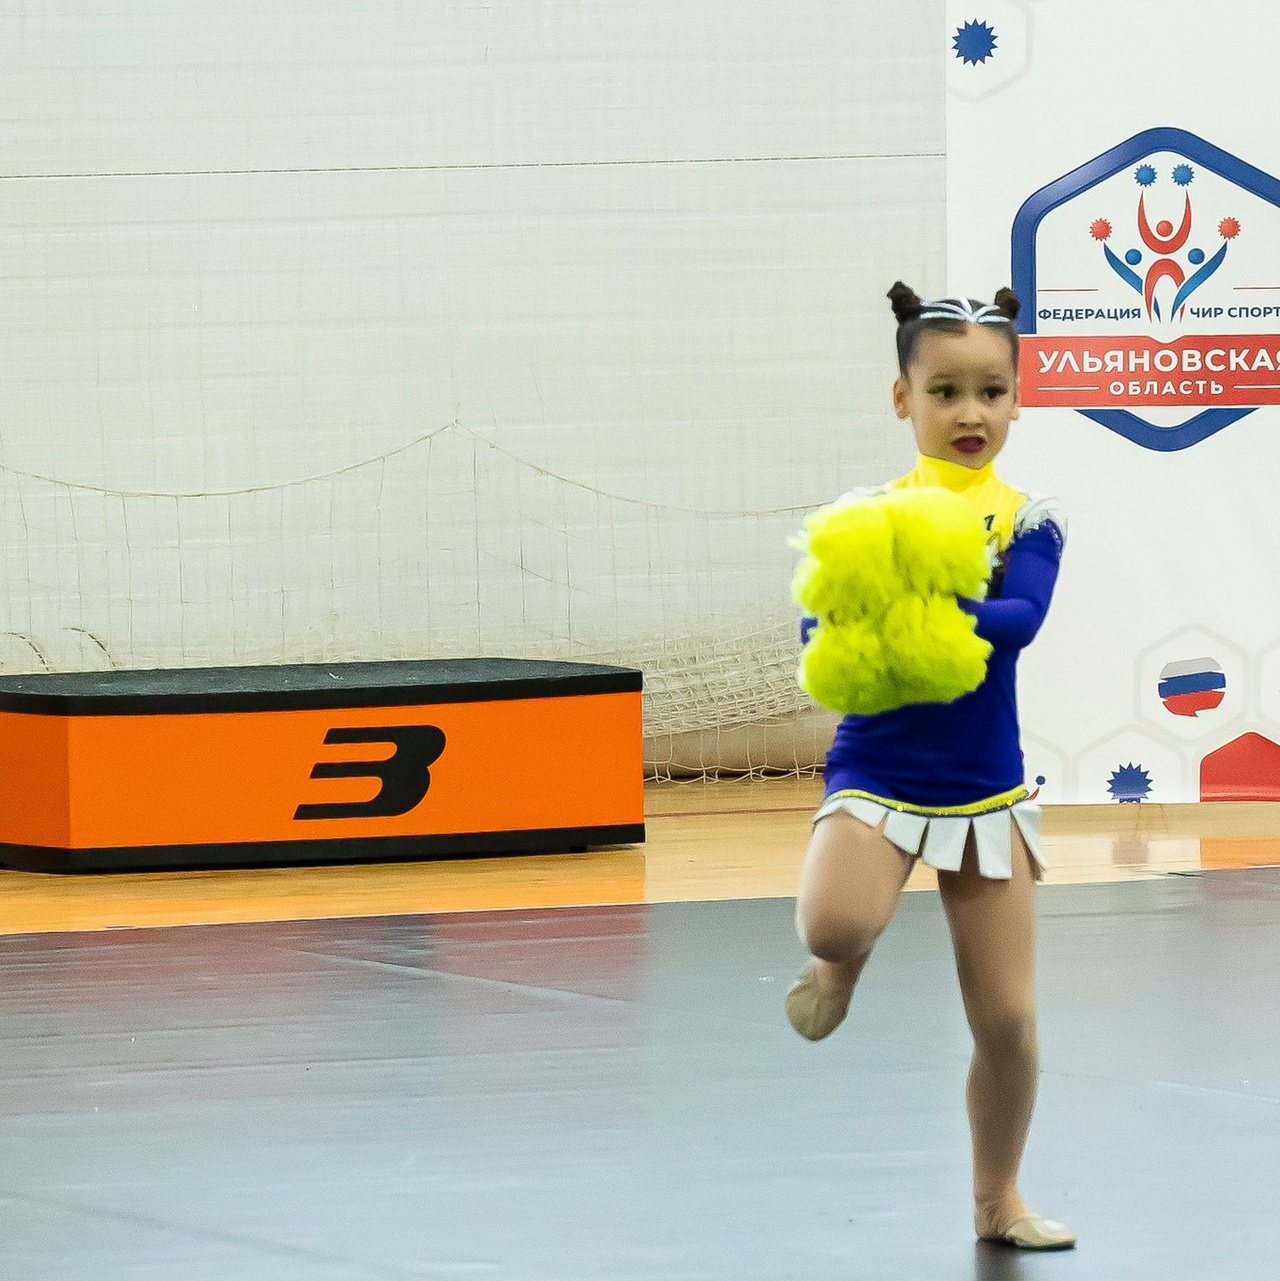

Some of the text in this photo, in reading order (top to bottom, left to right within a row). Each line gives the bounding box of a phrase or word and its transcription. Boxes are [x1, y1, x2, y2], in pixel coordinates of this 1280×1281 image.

[1037, 307, 1142, 322] ФЕДЕРАЦИЯ
[1189, 307, 1224, 319] ЧИР
[1036, 347, 1280, 374] УЛЬЯНОВСКА
[1108, 380, 1224, 396] ОБЛАСТЬ
[292, 724, 447, 821] 3
